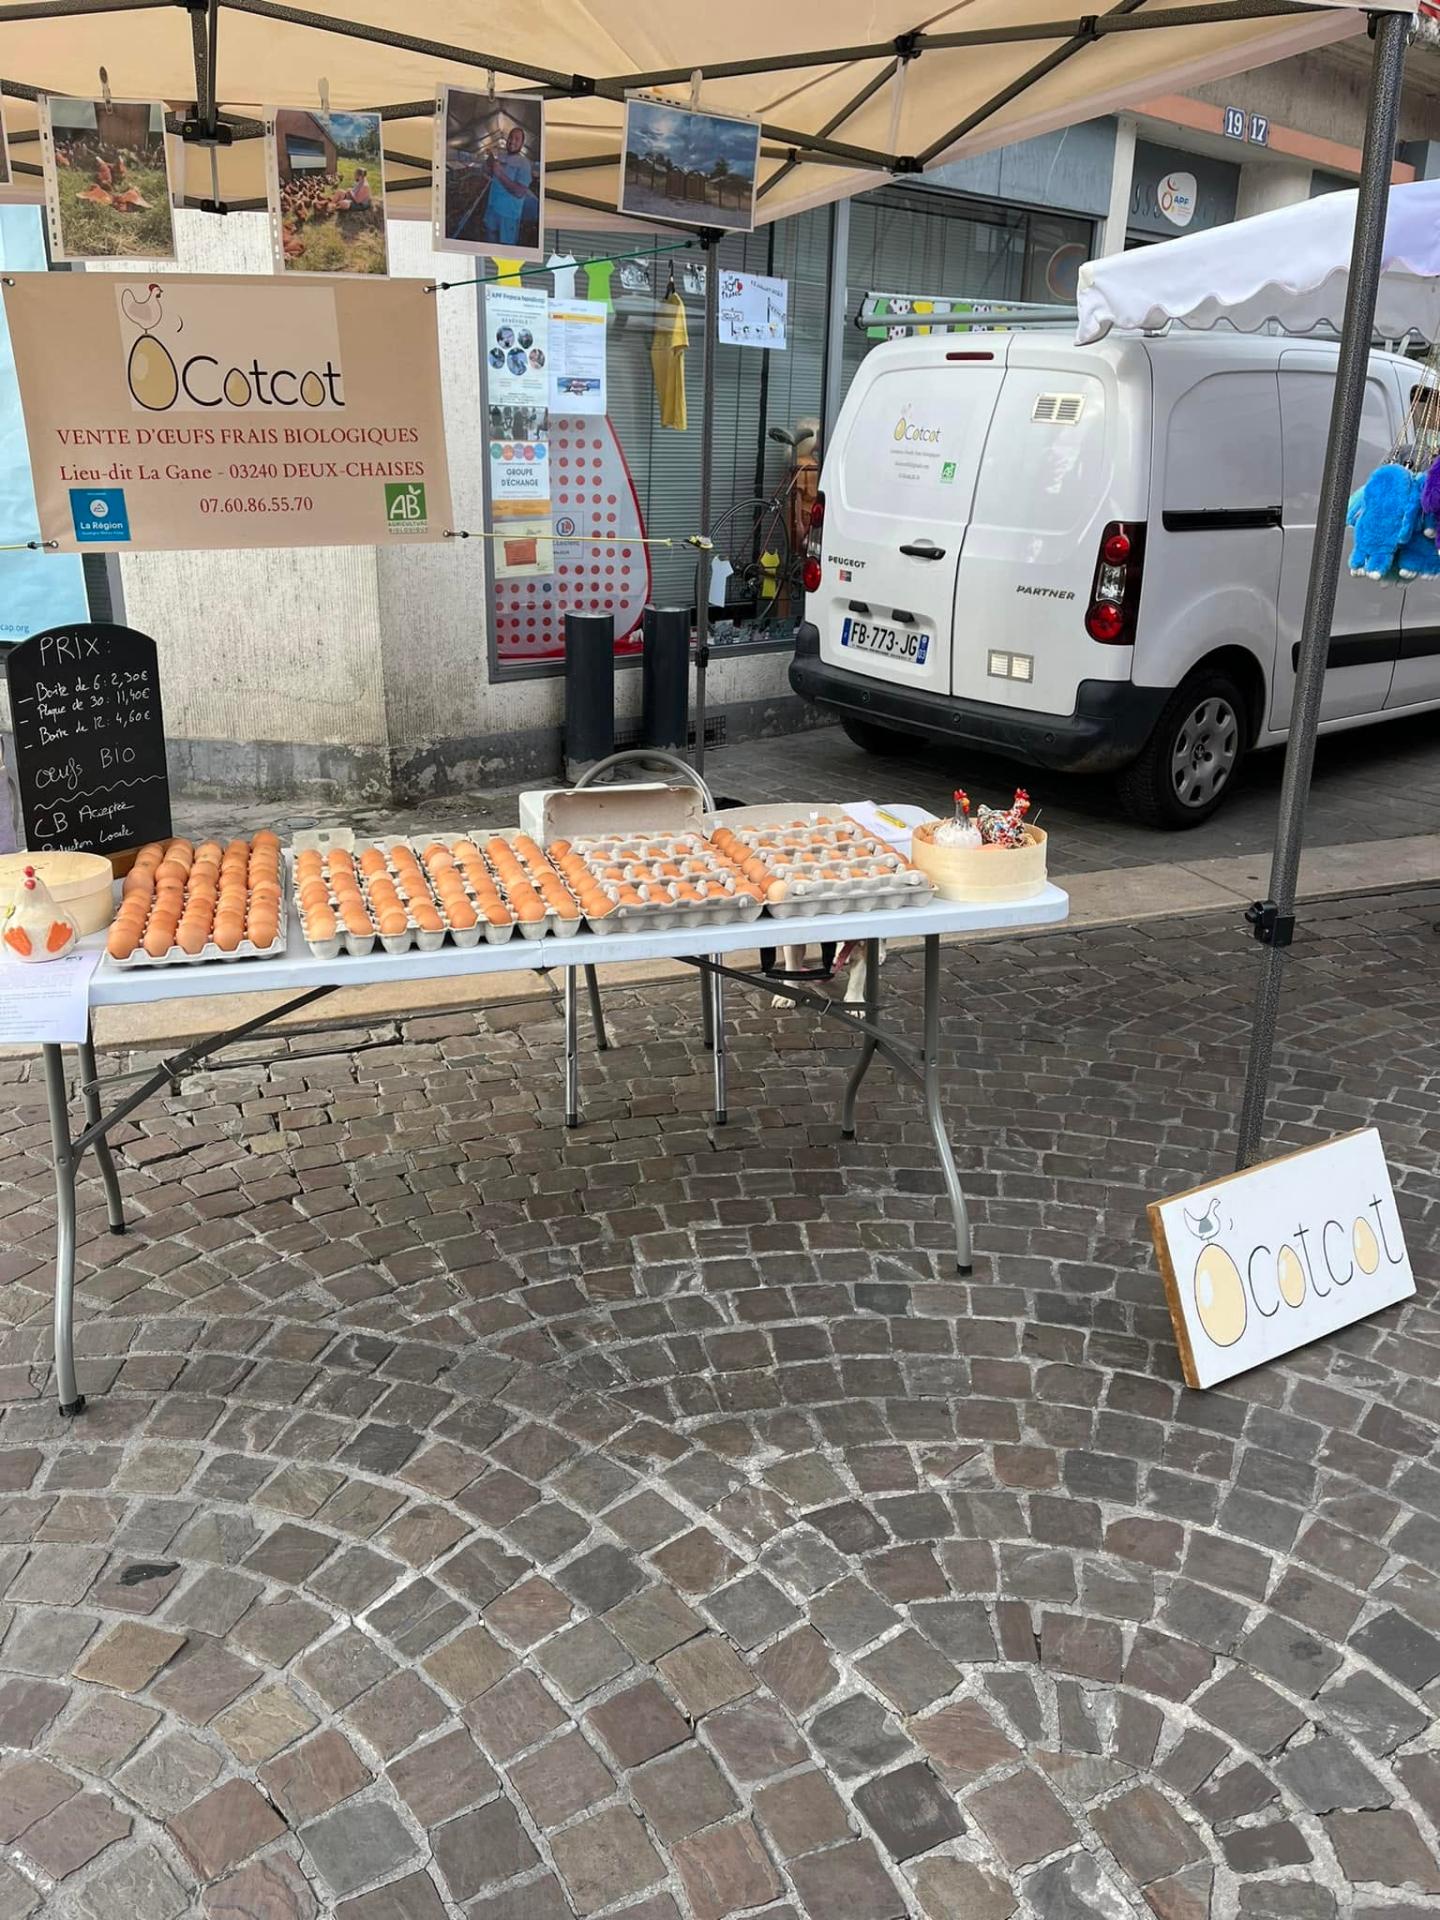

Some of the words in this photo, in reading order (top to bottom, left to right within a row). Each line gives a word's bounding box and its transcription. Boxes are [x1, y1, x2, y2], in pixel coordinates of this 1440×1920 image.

[1227, 110, 1243, 135] 19
[1251, 117, 1267, 141] 17
[57, 429, 131, 445] VENTE
[221, 428, 279, 444] FRAIS
[284, 427, 419, 446] BIOLOGIQUES
[60, 463, 134, 481] Lieu-dit
[138, 465, 161, 480] La
[165, 464, 212, 480] Gane
[229, 463, 279, 479] 03240
[283, 461, 425, 479] DEUX-CHAISES
[506, 468, 533, 476] GROUPE
[200, 497, 313, 513] 07.60.86.55.70
[390, 494, 420, 519] AB
[80, 521, 91, 529] La
[92, 521, 123, 531] Région
[828, 555, 866, 568] PEUGEOT
[1016, 585, 1075, 600] PARTNER
[75, 676, 89, 691] de
[72, 698, 84, 710] de
[75, 720, 88, 733] de
[100, 743, 136, 769] BIO
[34, 812, 68, 837] CB
